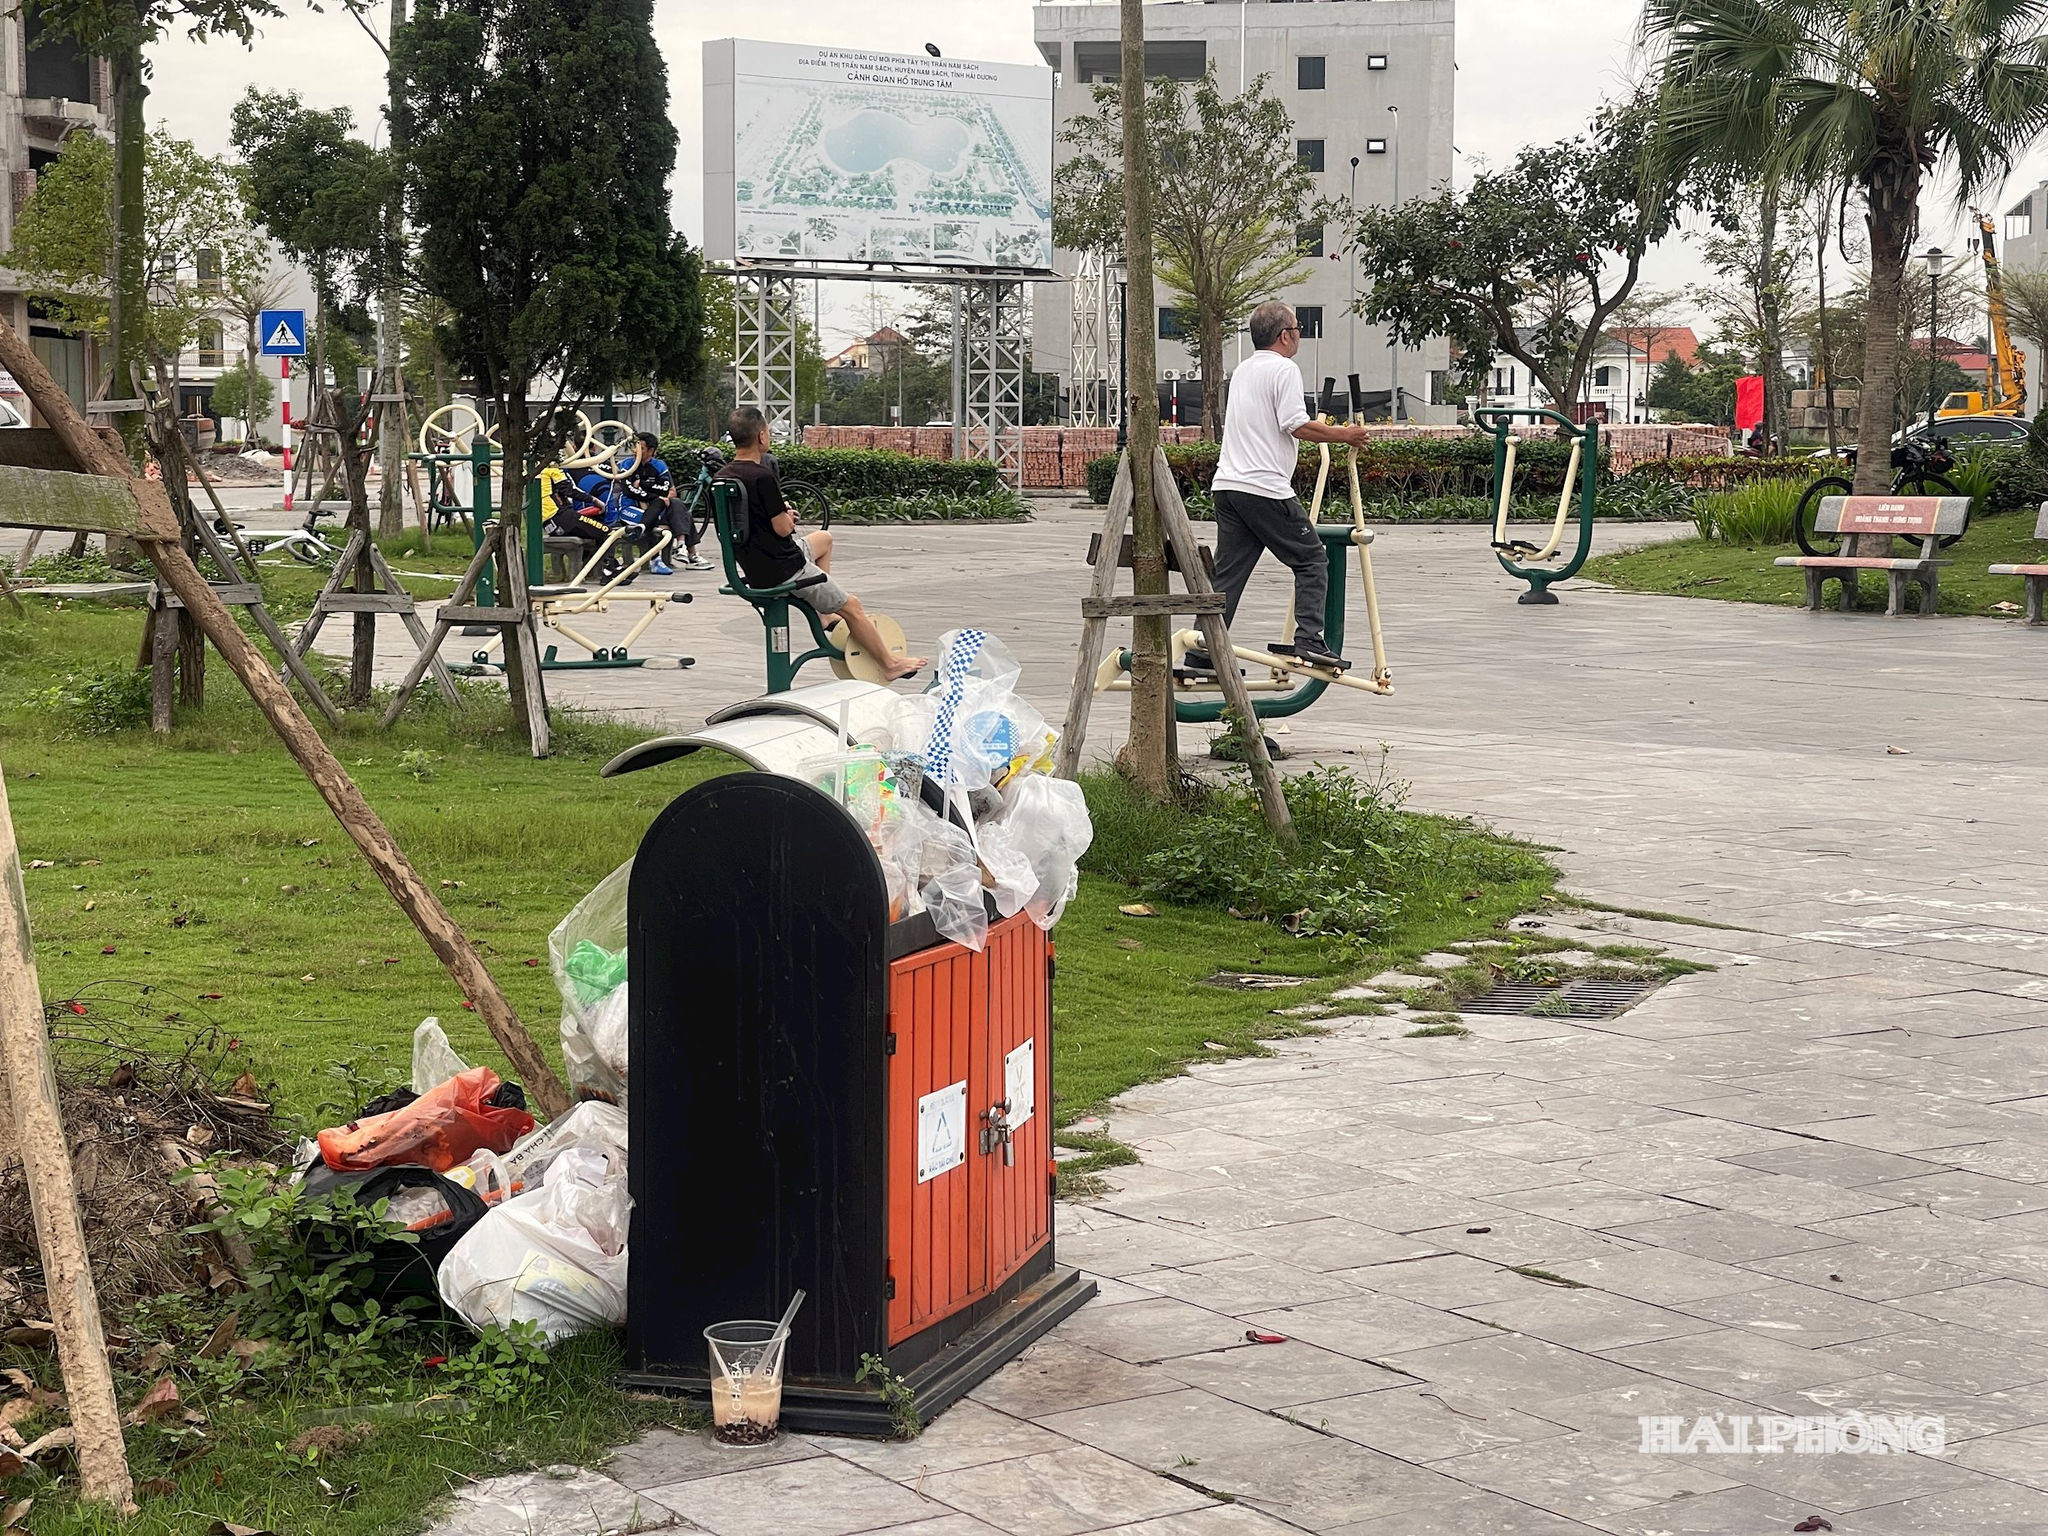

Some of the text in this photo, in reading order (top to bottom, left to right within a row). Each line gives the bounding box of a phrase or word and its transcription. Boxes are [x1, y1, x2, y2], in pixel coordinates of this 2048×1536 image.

[830, 61, 841, 69] THỊ
[841, 60, 859, 69] TRẤN
[847, 70, 953, 88] CẢNH QUAN HỒ TRUNG TÂM
[578, 515, 610, 533] JUMBO
